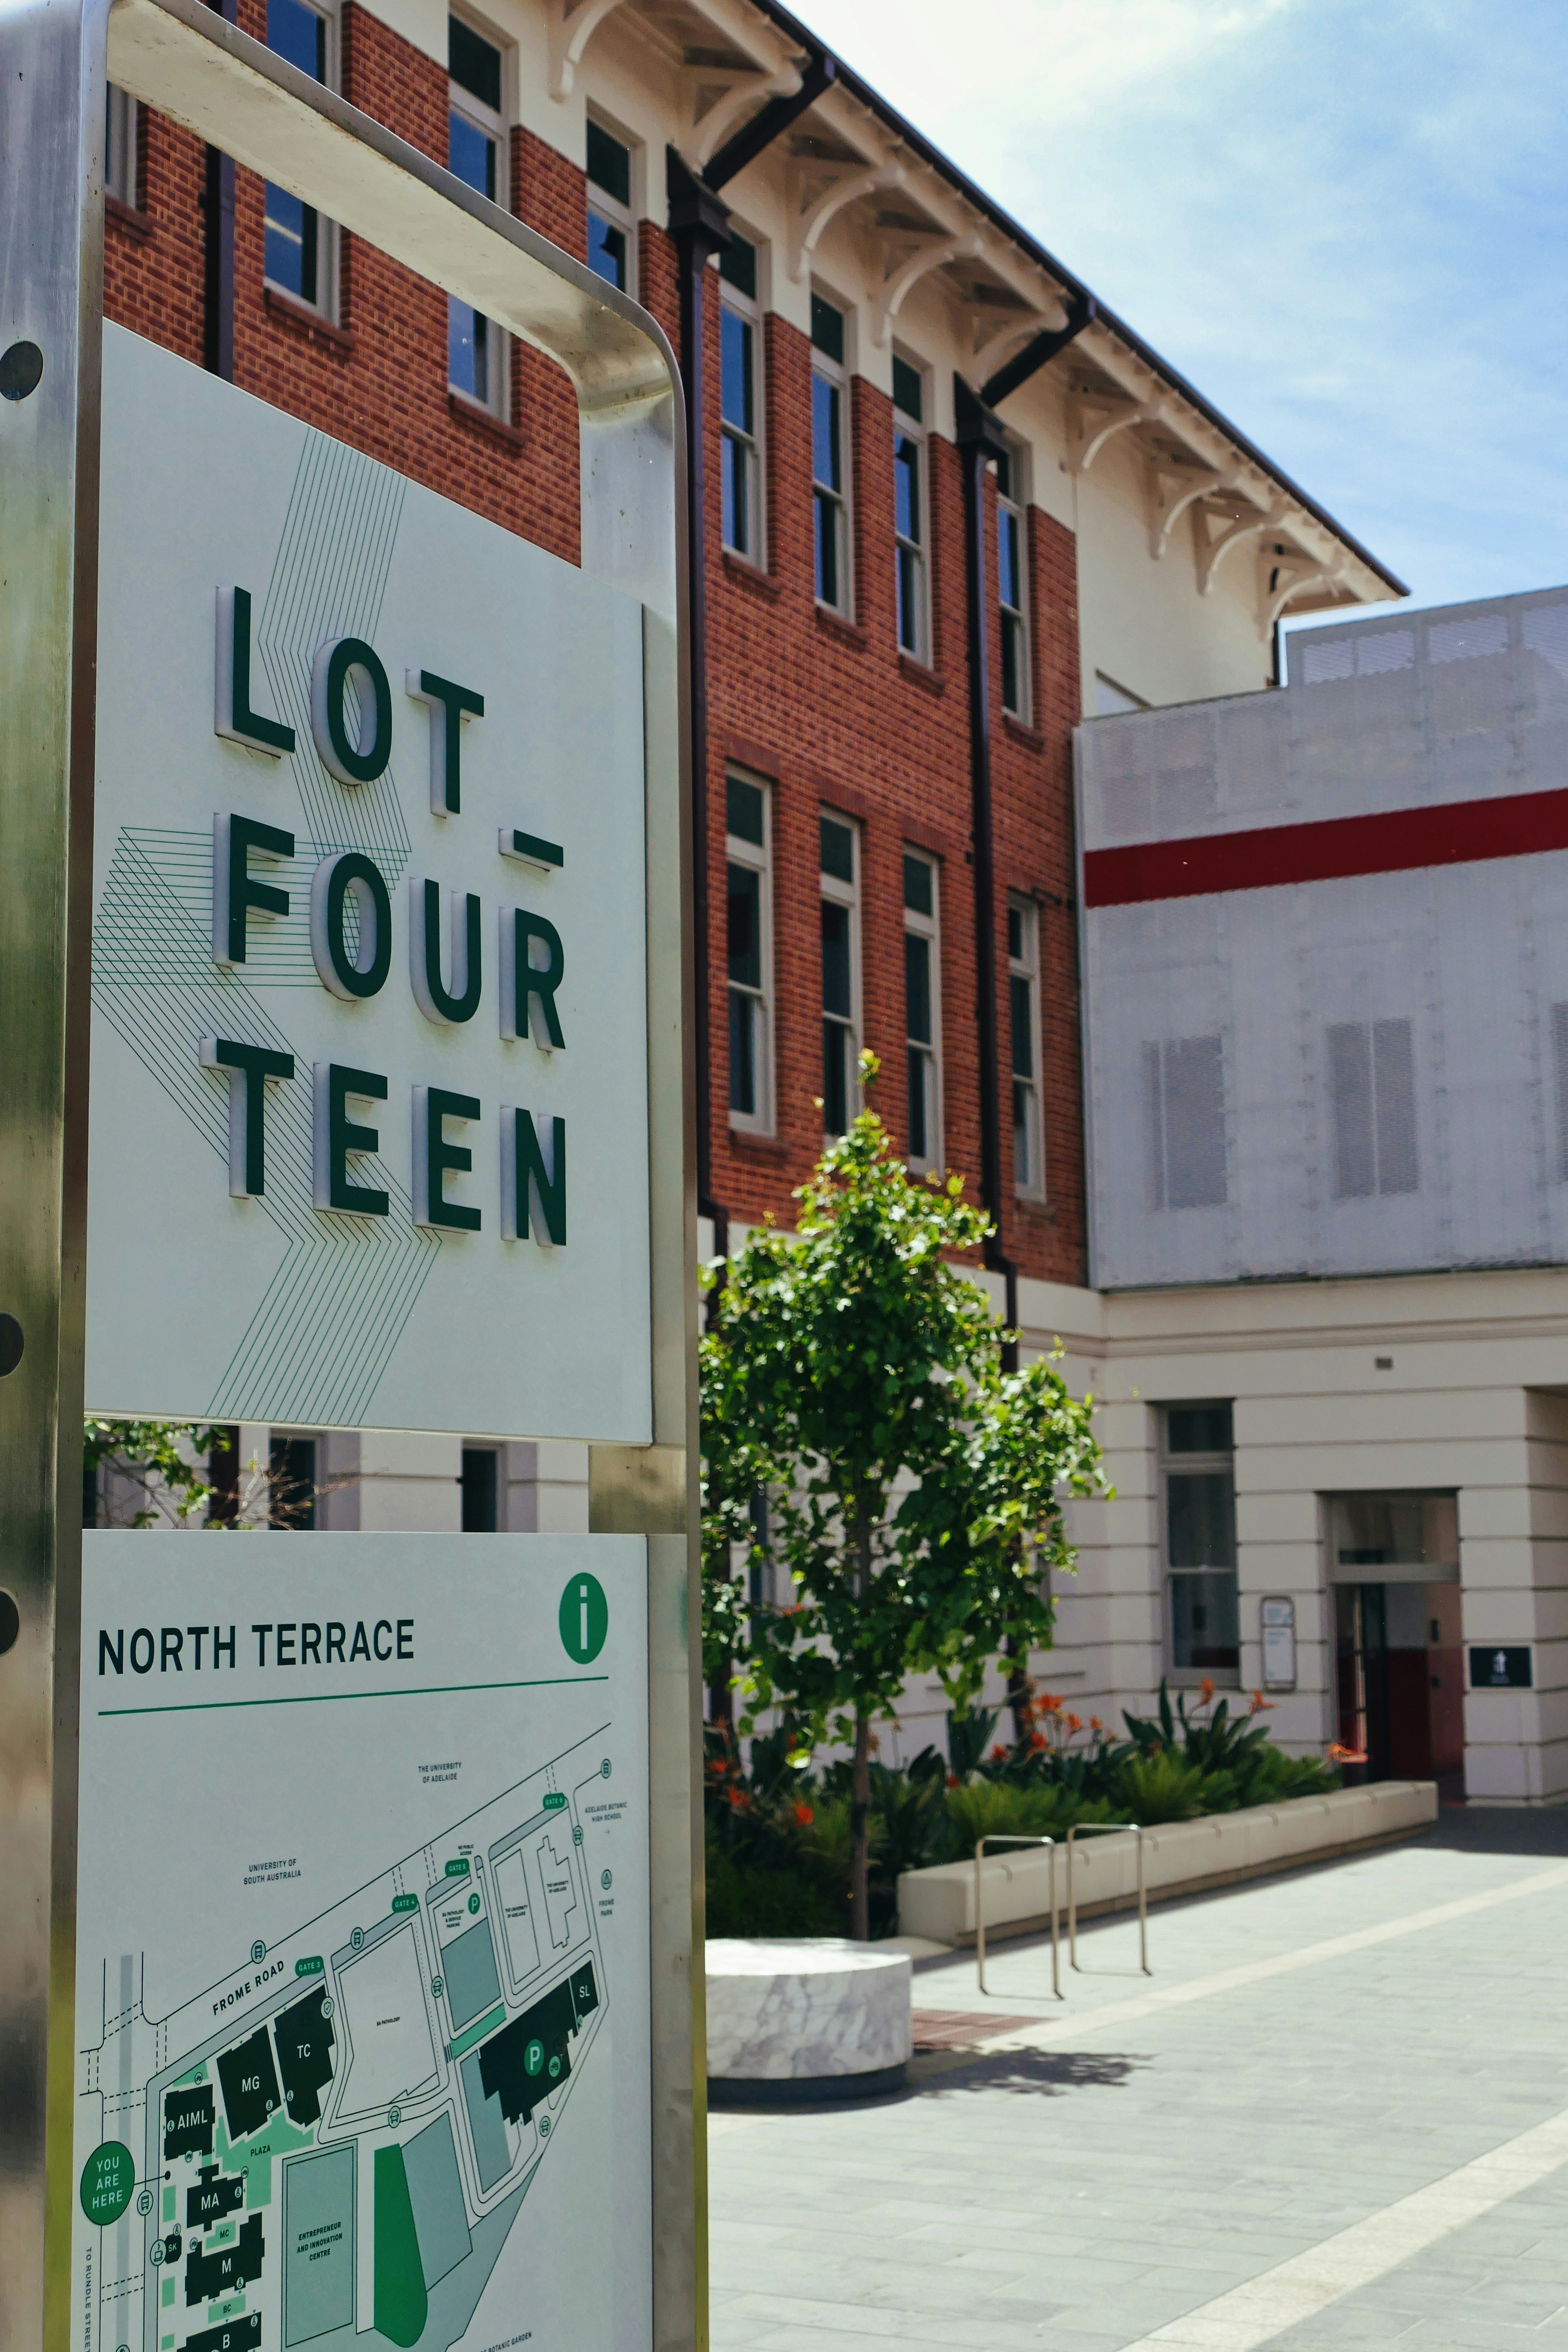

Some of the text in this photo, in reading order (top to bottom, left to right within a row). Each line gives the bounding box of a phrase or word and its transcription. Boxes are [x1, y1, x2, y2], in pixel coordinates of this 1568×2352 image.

[214, 813, 566, 1050] FOUR
[199, 1036, 567, 1246] TEEN
[98, 1619, 414, 1675] NORTH TERRACE
[430, 1762, 461, 1771] UNIVERSITY
[432, 1773, 457, 1782] ADELAIDE
[585, 1801, 627, 1813] ADELAIDE BOTANIC
[249, 1860, 286, 1872] UNIVERSITY
[244, 1870, 301, 1884] SOUTH AUSTRALIA
[395, 1899, 409, 1908] GATE
[298, 1962, 315, 1972] GATE
[213, 1961, 284, 2015] FROME ROAD
[579, 1985, 590, 1998] SL
[297, 2043, 310, 2058] TC
[530, 2046, 540, 2070] P
[242, 2076, 260, 2092] MG
[178, 2110, 208, 2129] AIML
[251, 2144, 271, 2156] PLAZA
[97, 2156, 119, 2172] YOU
[96, 2173, 119, 2191] ARE
[92, 2189, 123, 2209] HERE
[201, 2193, 219, 2210] MA
[220, 2230, 229, 2239] MC
[299, 2221, 341, 2241] ENTREPRENEUR
[168, 2242, 177, 2252] SK
[297, 2233, 343, 2254] AND INNOVATION
[86, 2246, 92, 2261] TO
[309, 2248, 331, 2261] CENTRE
[222, 2257, 231, 2274] M
[223, 2304, 231, 2313] BC
[223, 2334, 230, 2349] B
[511, 2331, 532, 2345] GARDEN
